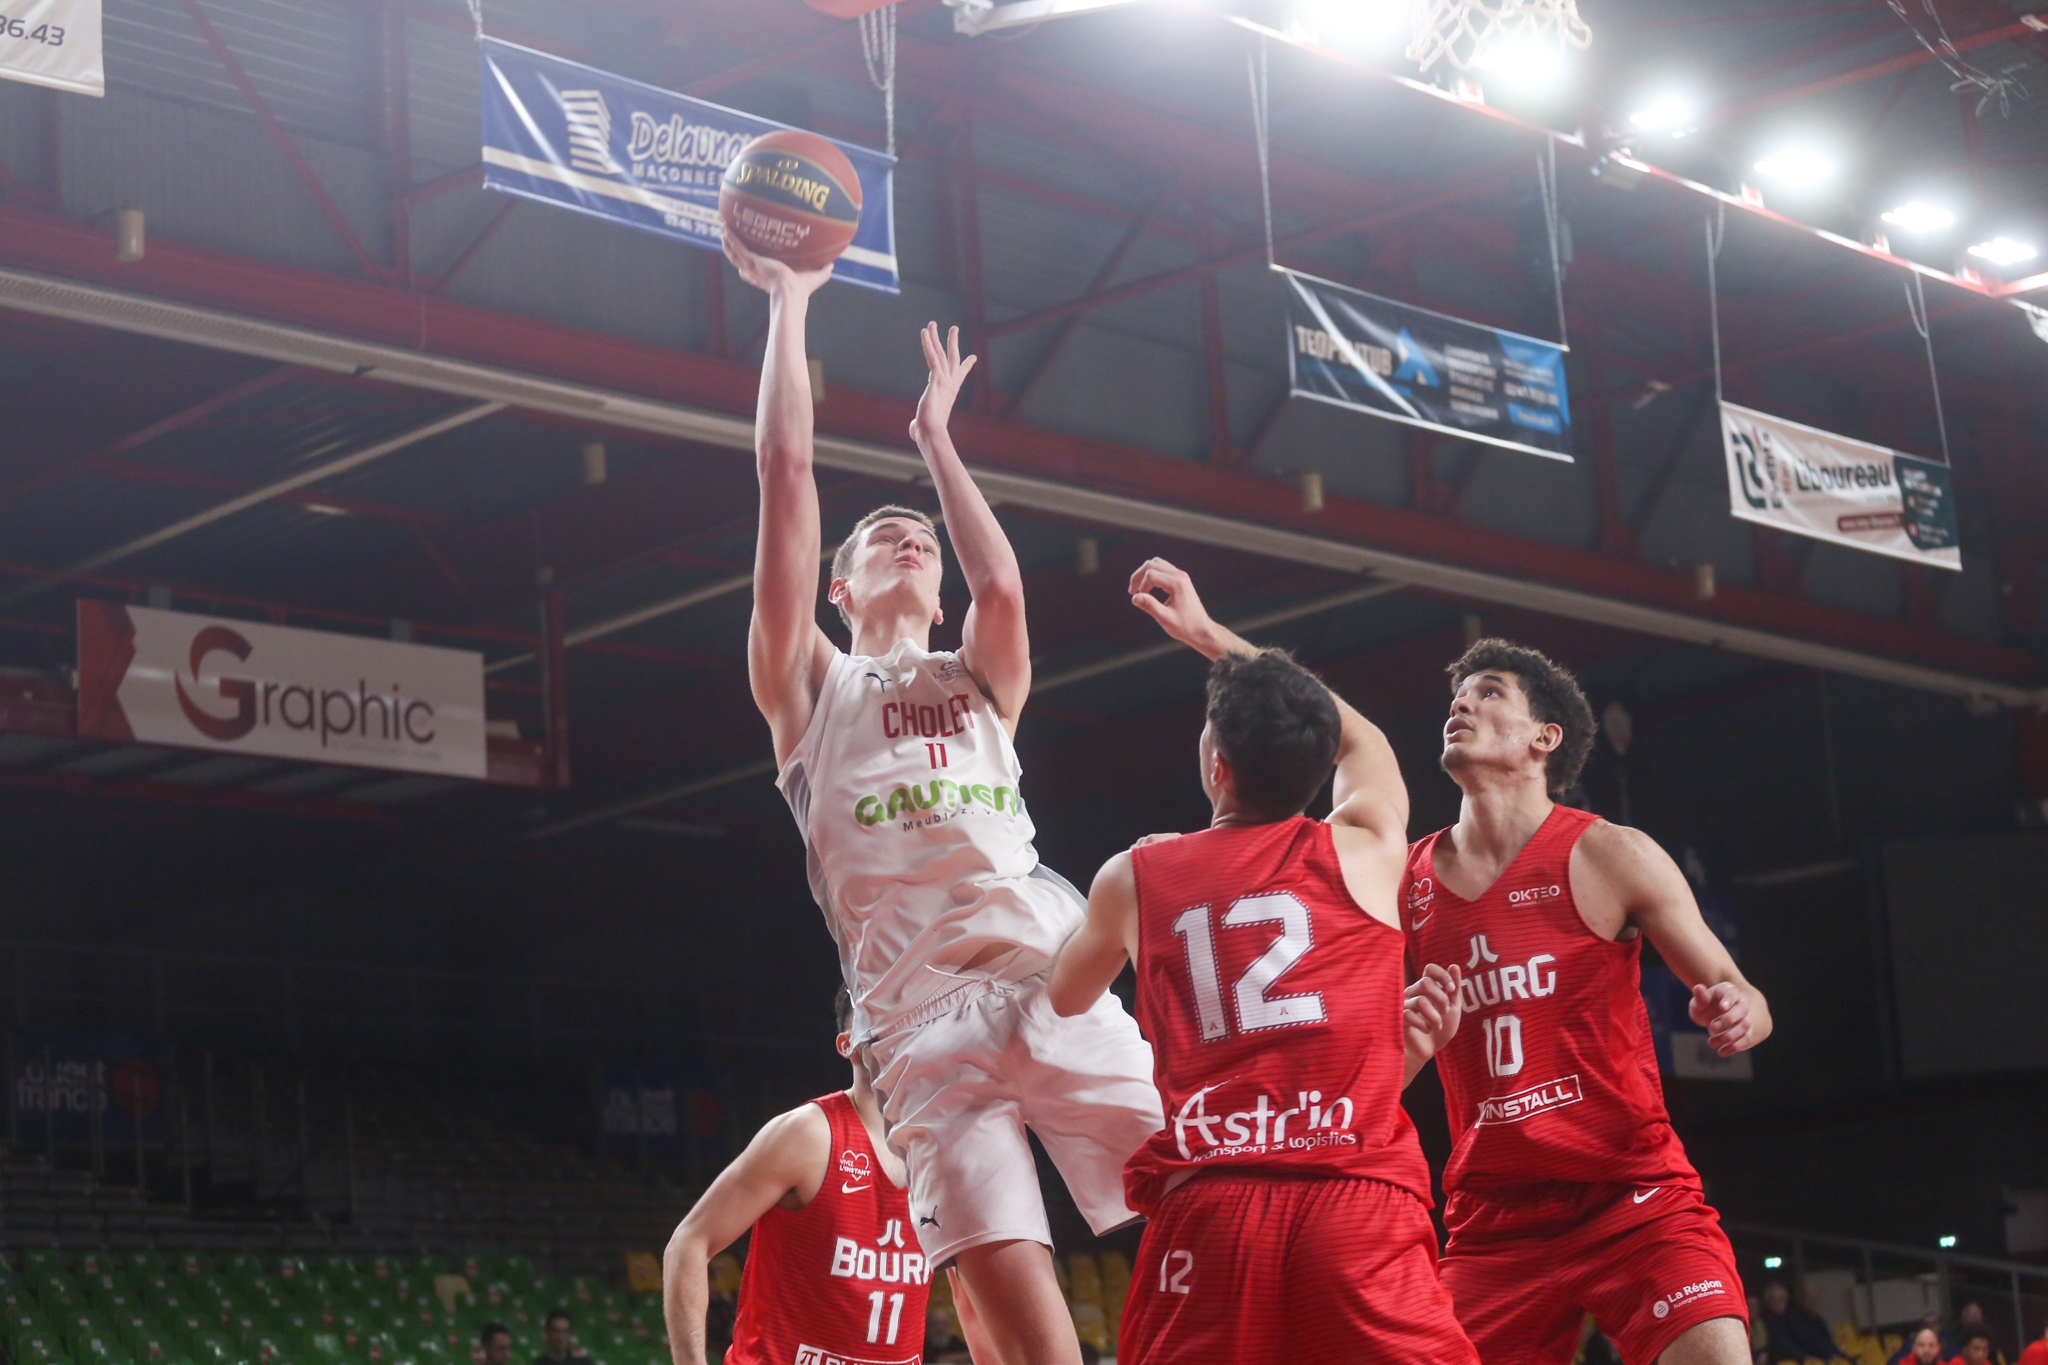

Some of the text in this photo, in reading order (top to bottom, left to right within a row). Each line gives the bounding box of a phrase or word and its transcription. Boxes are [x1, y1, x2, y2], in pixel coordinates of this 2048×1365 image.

[628, 112, 755, 166] Delauna
[737, 162, 830, 213] SPALDING
[174, 625, 435, 748] Graphic
[882, 694, 975, 739] CHOLET
[924, 743, 948, 769] 11
[1508, 884, 1561, 903] OKTEO
[1171, 890, 1328, 1044] 12
[1459, 953, 1557, 1013] OURG
[1483, 1014, 1524, 1078] 10
[1172, 1075, 1354, 1160] Astr'in
[1289, 1131, 1357, 1151] logistics
[839, 1164, 871, 1177] L'INSTANT
[1159, 1249, 1194, 1295] 12
[1668, 1279, 1722, 1304] La Région
[866, 1290, 905, 1345] 11
